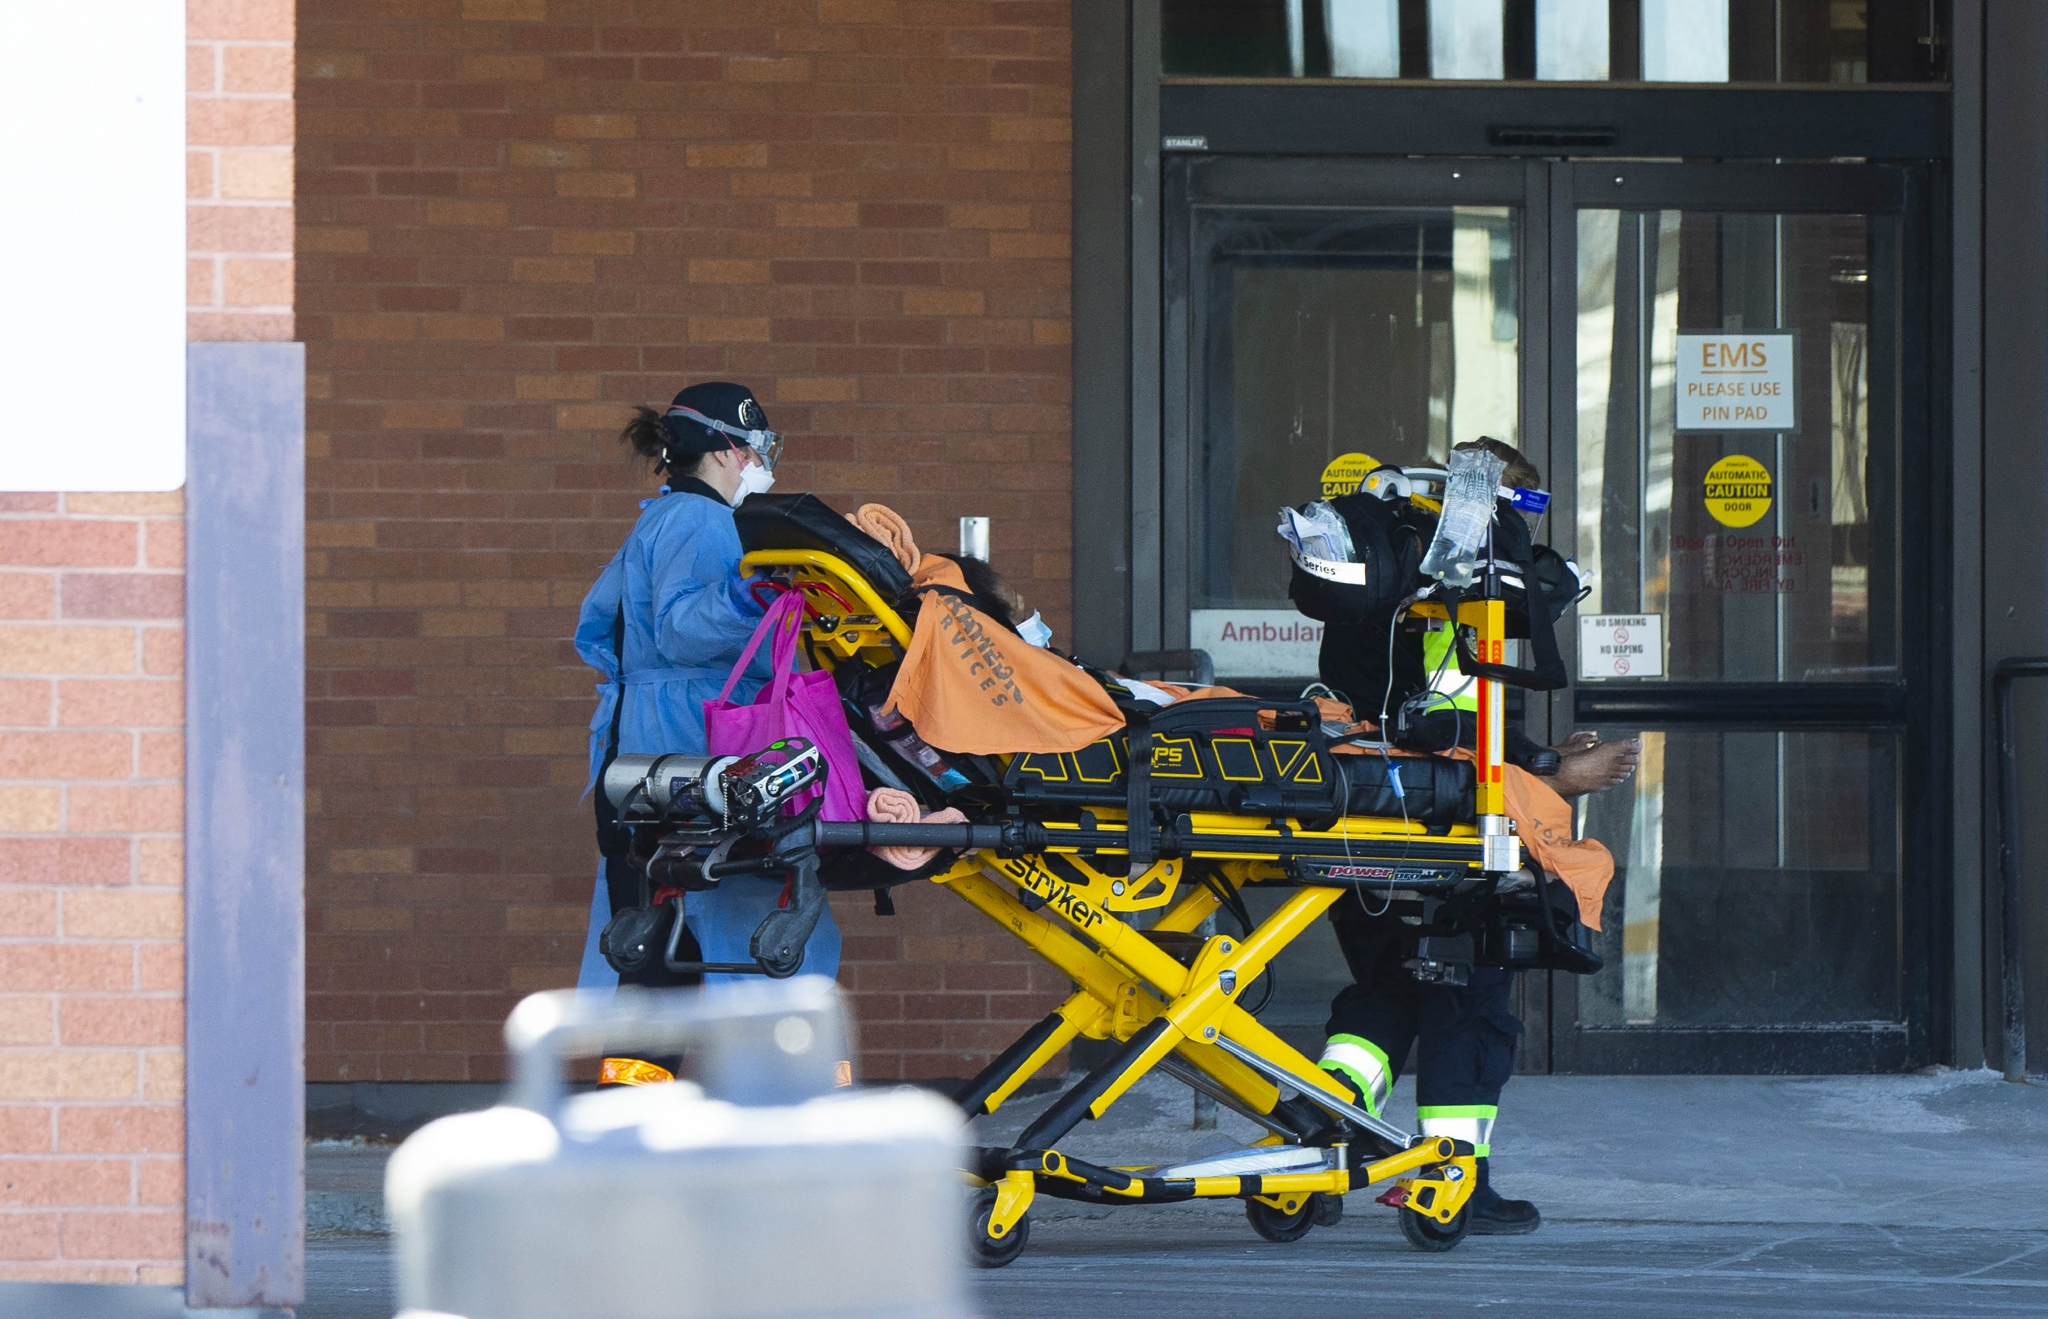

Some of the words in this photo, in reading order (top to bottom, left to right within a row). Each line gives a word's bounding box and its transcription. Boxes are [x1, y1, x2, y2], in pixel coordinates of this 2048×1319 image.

[1166, 139, 1204, 147] STANLEY
[1702, 342, 1767, 368] EMS
[1688, 382, 1745, 396] PLEASE
[1750, 382, 1781, 396] USE
[1702, 406, 1730, 420] PIN
[1735, 406, 1768, 420] PAD
[1326, 469, 1371, 478] AUTOMA
[1709, 470, 1767, 480] AUTOMATIC
[1706, 484, 1768, 498] CAUTION
[1724, 502, 1752, 512] DOOR
[1726, 534, 1764, 549] Open
[1771, 535, 1795, 548] Out
[1303, 556, 1336, 575] Series
[1595, 618, 1606, 627] NO
[1608, 617, 1646, 627] SMOKING
[1600, 645, 1611, 655] NO
[1613, 644, 1643, 655] VAPING
[1151, 747, 1183, 763] PS
[1328, 866, 1394, 878] power
[1004, 857, 1103, 928] stryker
